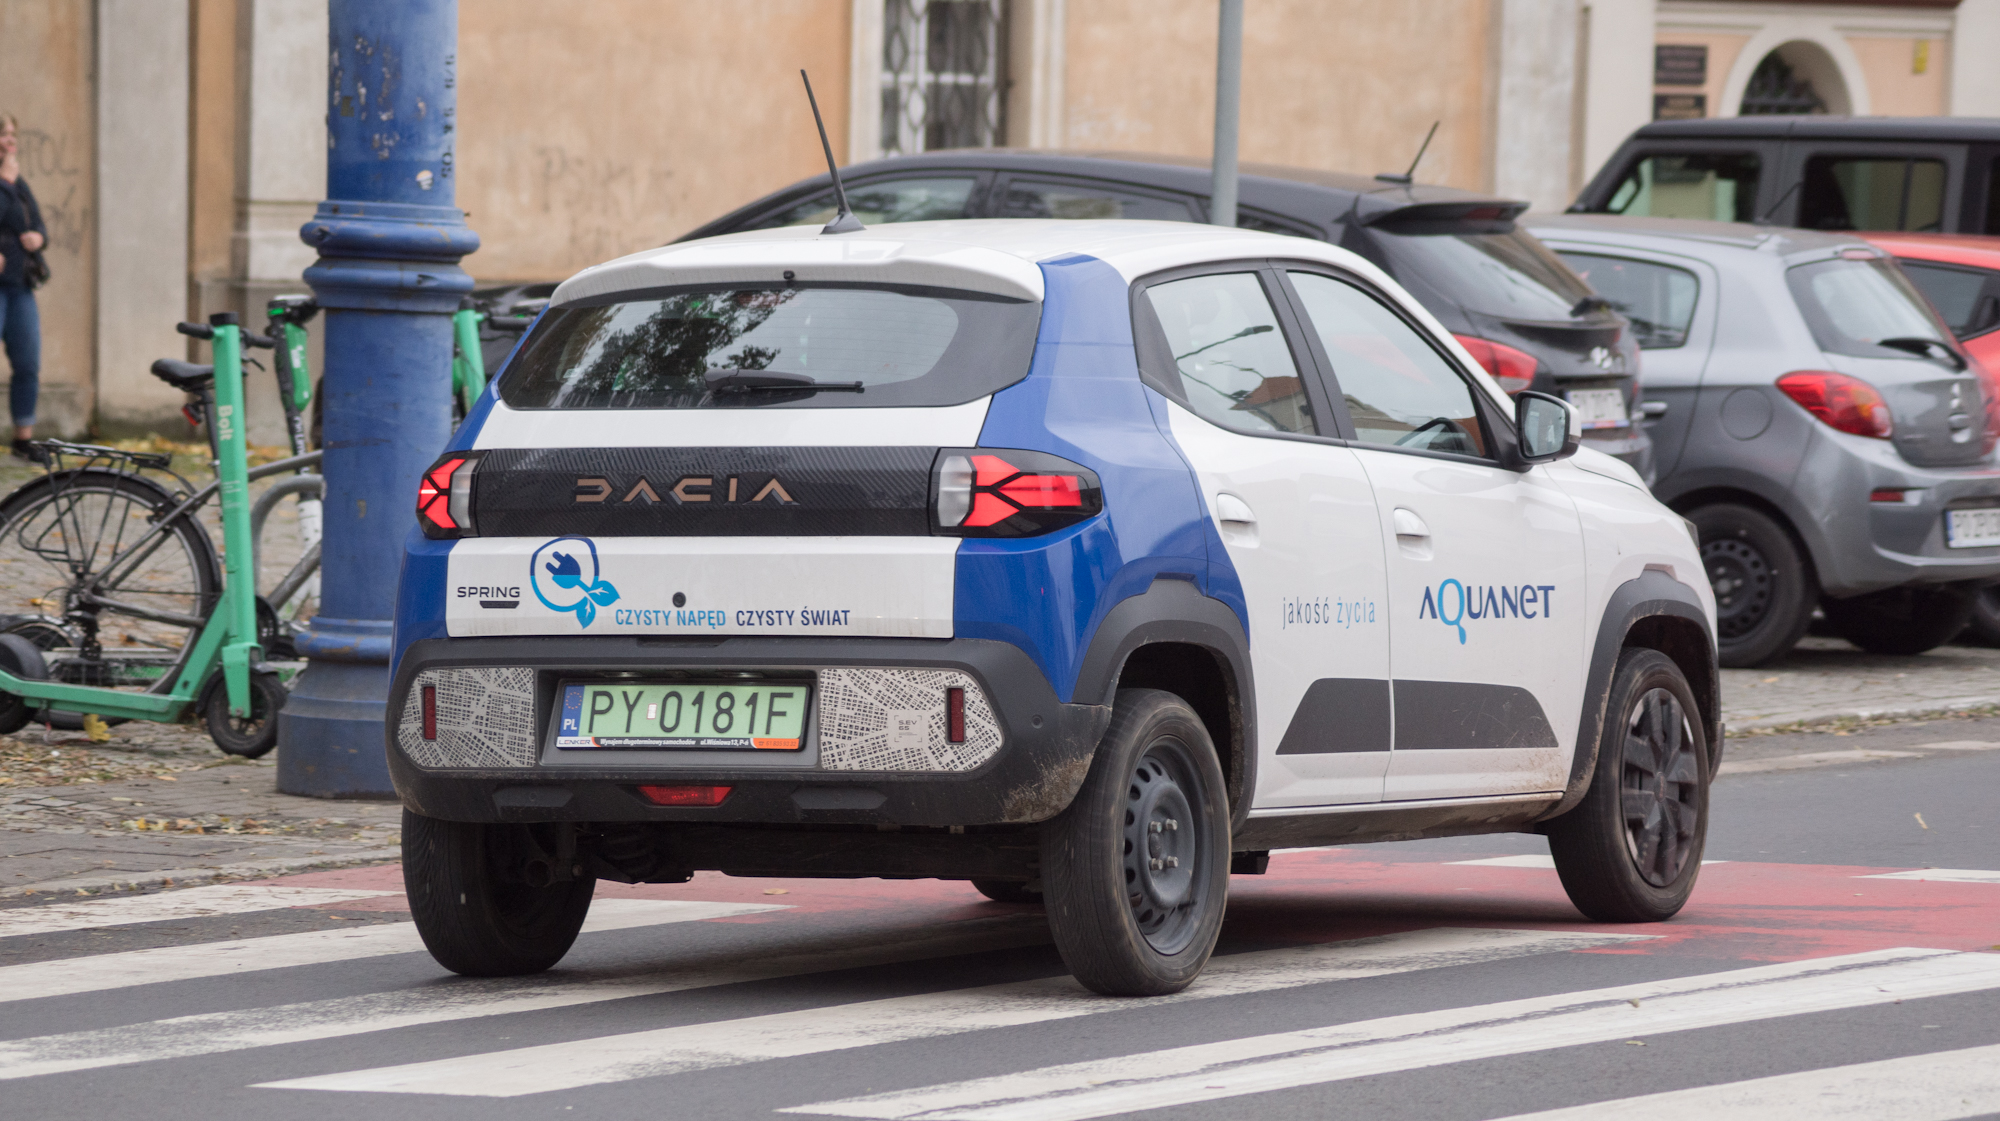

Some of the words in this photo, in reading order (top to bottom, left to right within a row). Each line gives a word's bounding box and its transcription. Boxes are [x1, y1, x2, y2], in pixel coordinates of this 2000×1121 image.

[218, 405, 234, 441] Bolt
[575, 477, 794, 502] DACIA
[457, 586, 520, 598] SPRING
[615, 608, 671, 627] CZYSTY
[677, 610, 726, 629] NAPĘD
[736, 609, 796, 627] CZYSTY
[800, 606, 851, 627] ŚWIAT
[1282, 596, 1330, 630] jakość
[1336, 596, 1376, 629] życia
[1418, 578, 1556, 645] AQUANET
[563, 718, 578, 731] PL
[587, 690, 645, 734] PY
[659, 690, 795, 735] 0181F
[600, 738, 622, 746] Wynajem
